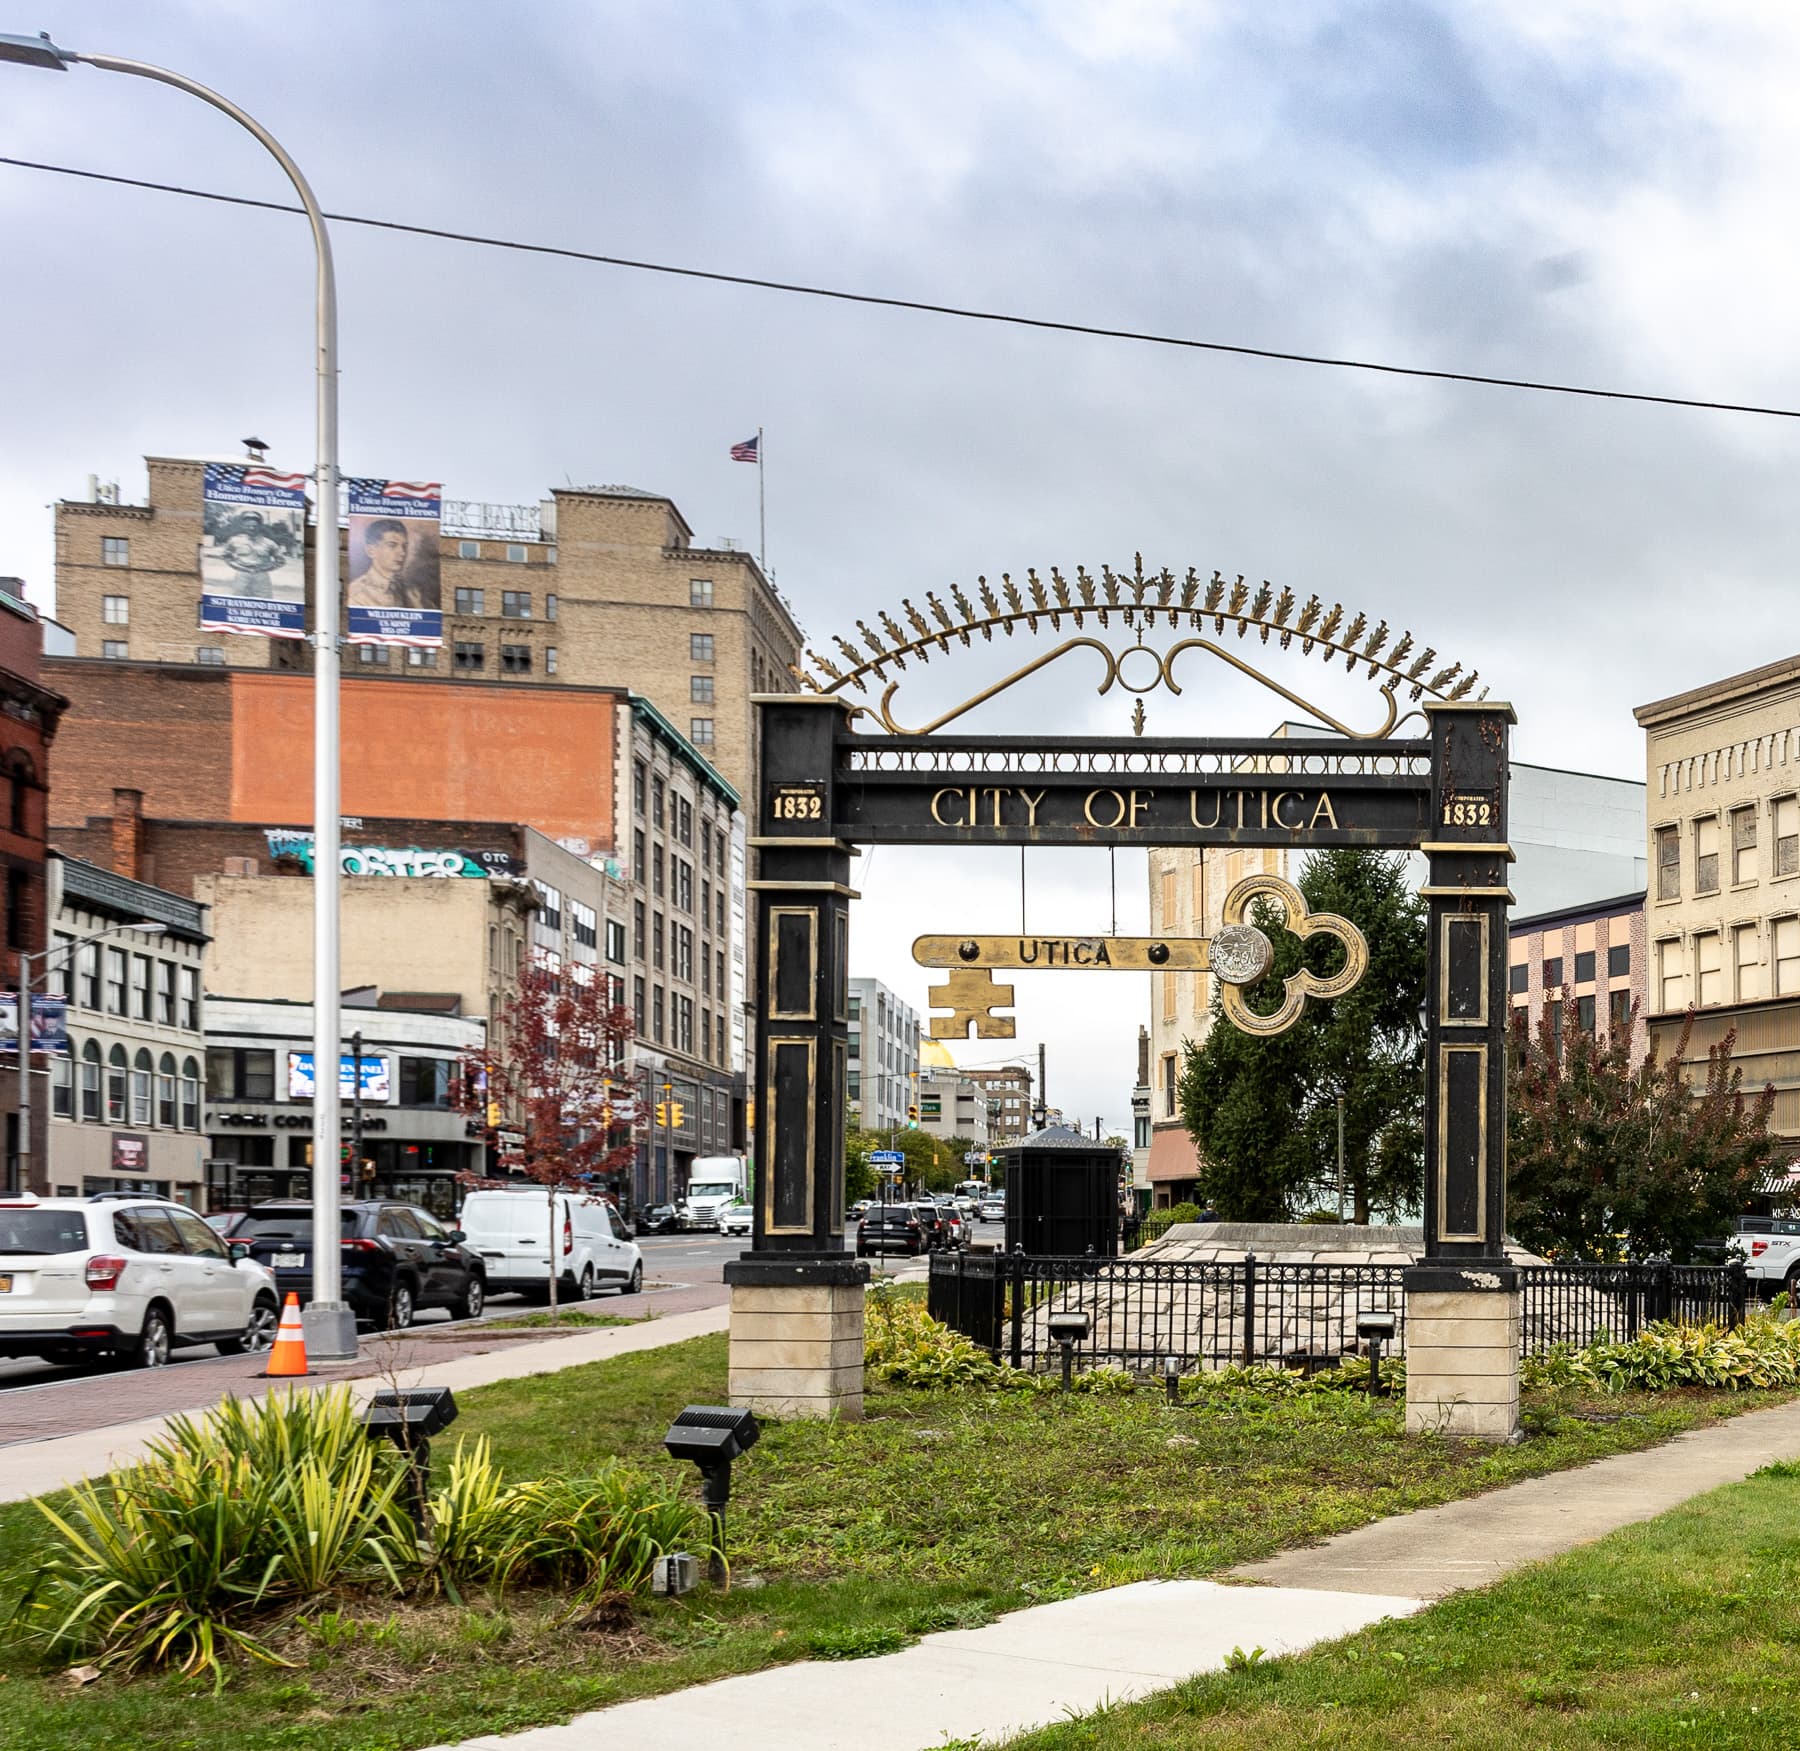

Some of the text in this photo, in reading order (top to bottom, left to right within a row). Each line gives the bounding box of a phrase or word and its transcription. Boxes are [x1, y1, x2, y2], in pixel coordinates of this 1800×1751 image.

[206, 489, 304, 508] Hometown Heroes
[243, 485, 273, 496] Honors
[276, 489, 295, 499] Our
[350, 503, 438, 518] Hometown Heroes
[382, 497, 412, 508] Honors
[413, 499, 430, 509] Our
[773, 796, 822, 819] 1832
[931, 787, 1340, 830] CITY OF UTICA
[1442, 803, 1491, 826] 1832
[482, 853, 509, 864] OTC
[1018, 939, 1112, 966] UTICA
